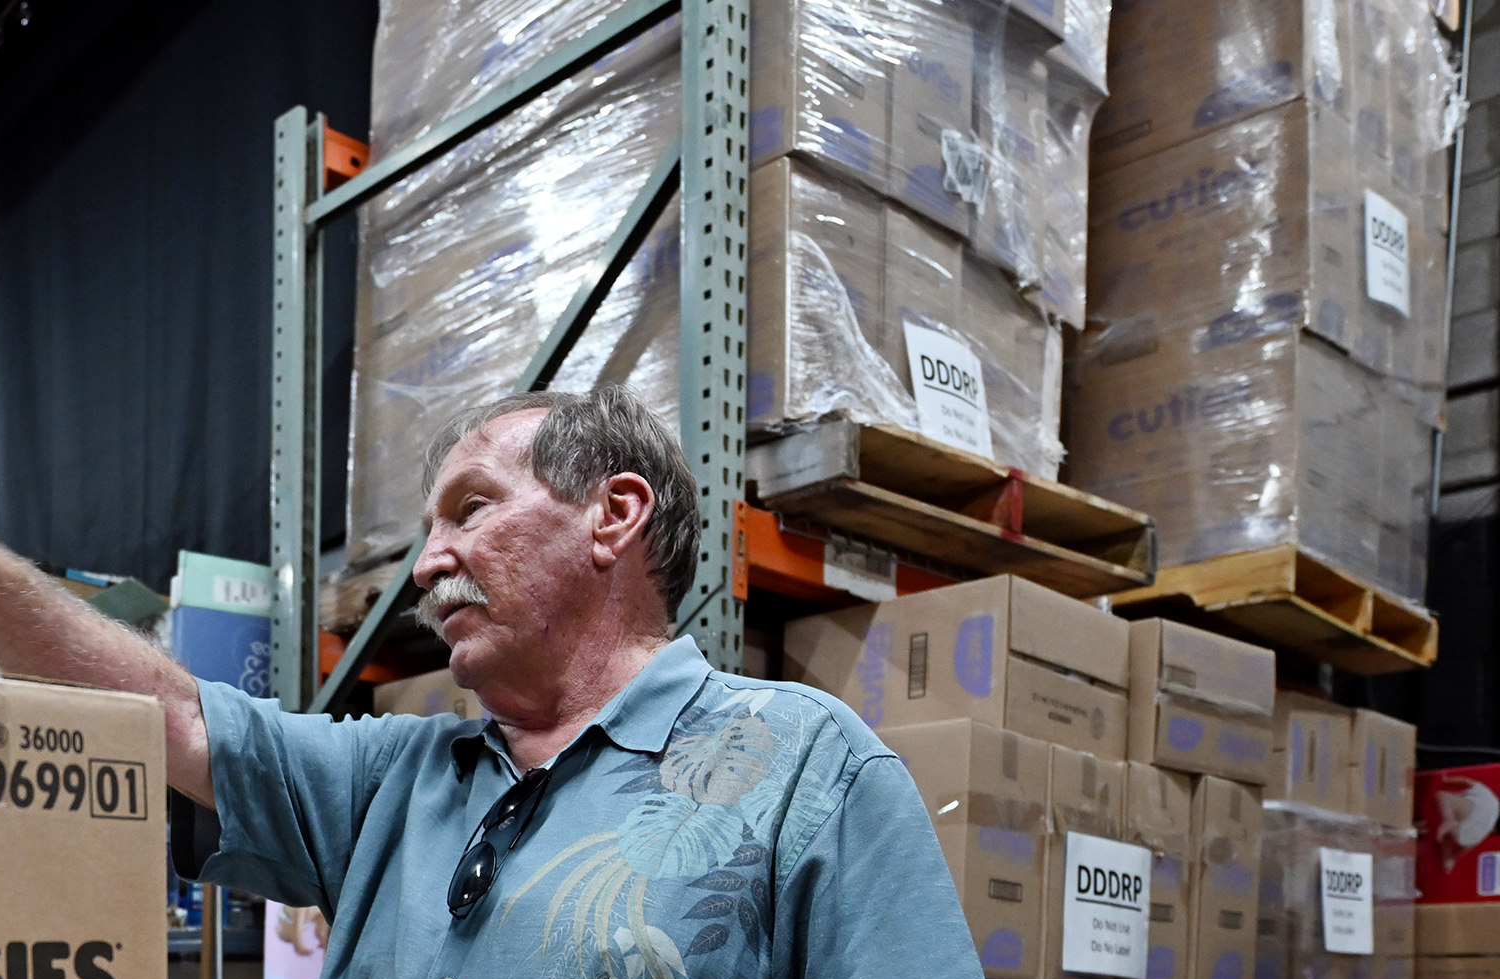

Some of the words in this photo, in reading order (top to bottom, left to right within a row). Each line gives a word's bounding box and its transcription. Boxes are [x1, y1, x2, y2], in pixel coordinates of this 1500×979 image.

[921, 354, 979, 401] DDDRP
[19, 724, 84, 754] 36000
[97, 767, 139, 814] 01
[1077, 865, 1142, 903] DDDRP
[1093, 917, 1103, 930] Do
[1091, 940, 1101, 952] Do
